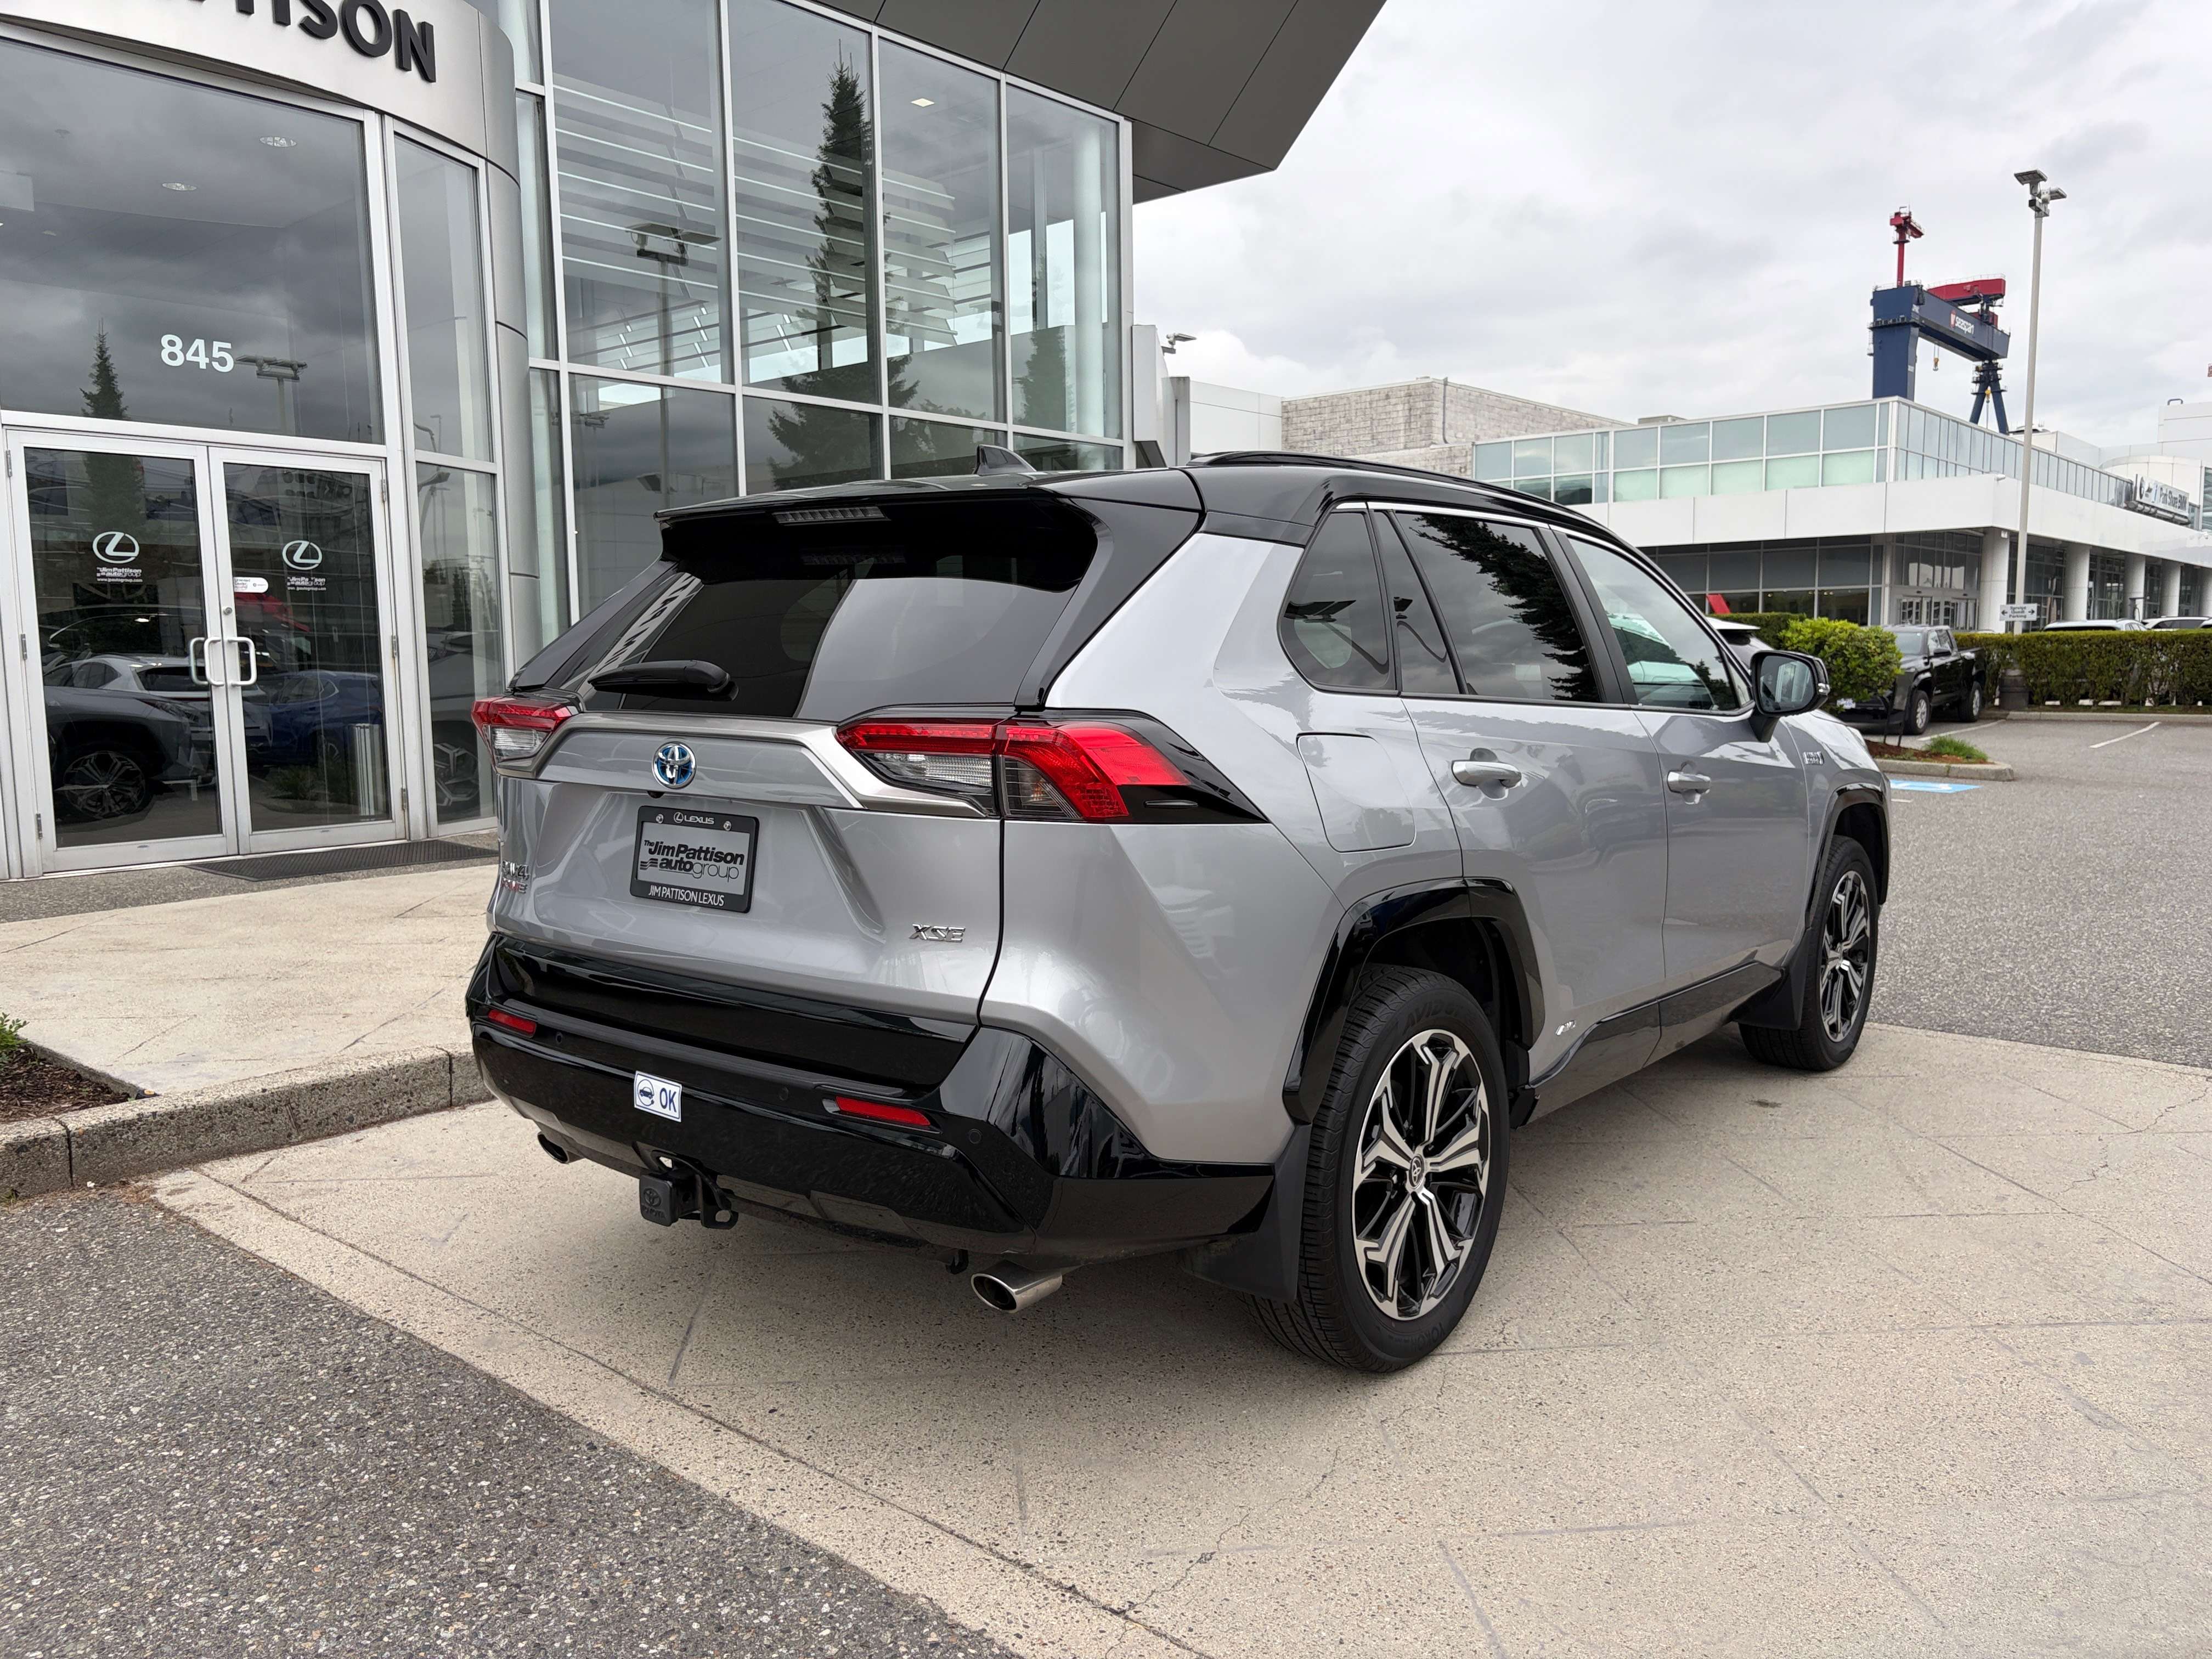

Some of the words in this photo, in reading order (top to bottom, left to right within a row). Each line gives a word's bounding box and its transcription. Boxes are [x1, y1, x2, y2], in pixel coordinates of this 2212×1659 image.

[236, 0, 437, 83] SON
[160, 334, 235, 373] 845
[2168, 489, 2177, 509] Shore
[684, 815, 715, 825] LEXUS
[659, 856, 740, 883] autogroup
[648, 884, 662, 898] JIM
[661, 886, 698, 903] PATTISON
[698, 891, 725, 907] LEXUS
[909, 923, 966, 943] XSE
[659, 1087, 677, 1113] OK
